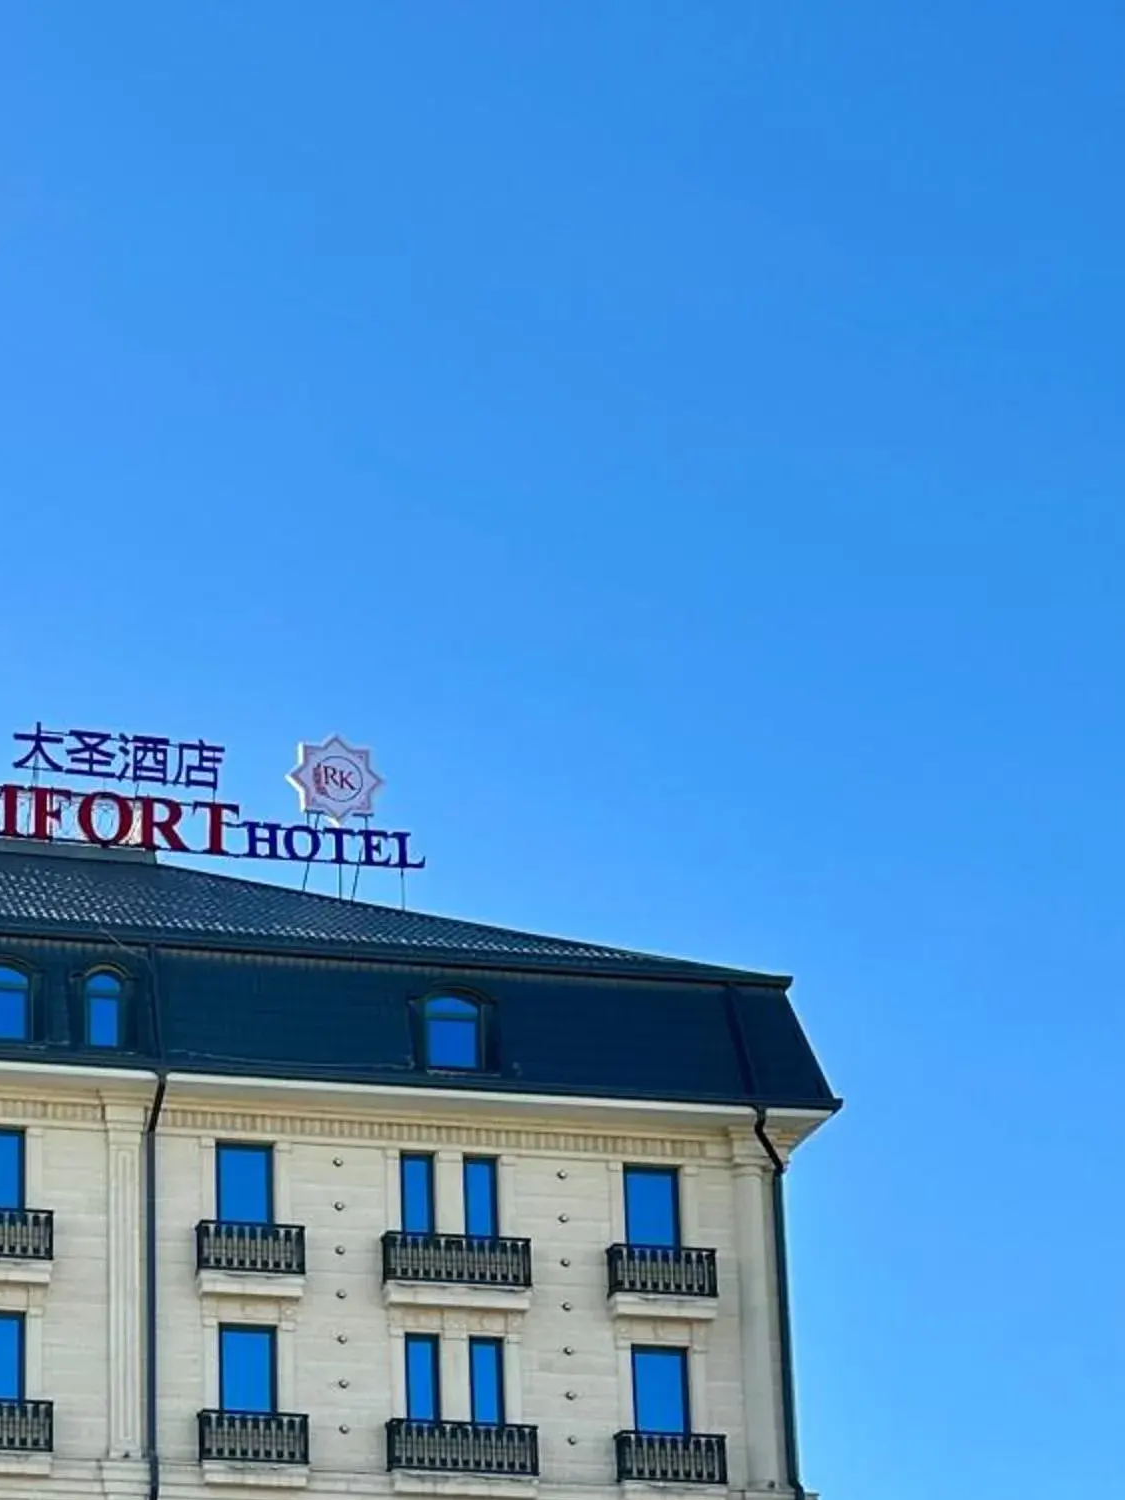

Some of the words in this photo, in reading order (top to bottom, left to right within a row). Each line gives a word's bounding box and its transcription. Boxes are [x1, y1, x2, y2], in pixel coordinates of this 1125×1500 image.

[13, 722, 225, 790] 大圣酒店
[322, 764, 357, 792] RK
[244, 821, 426, 869] HOTEL
